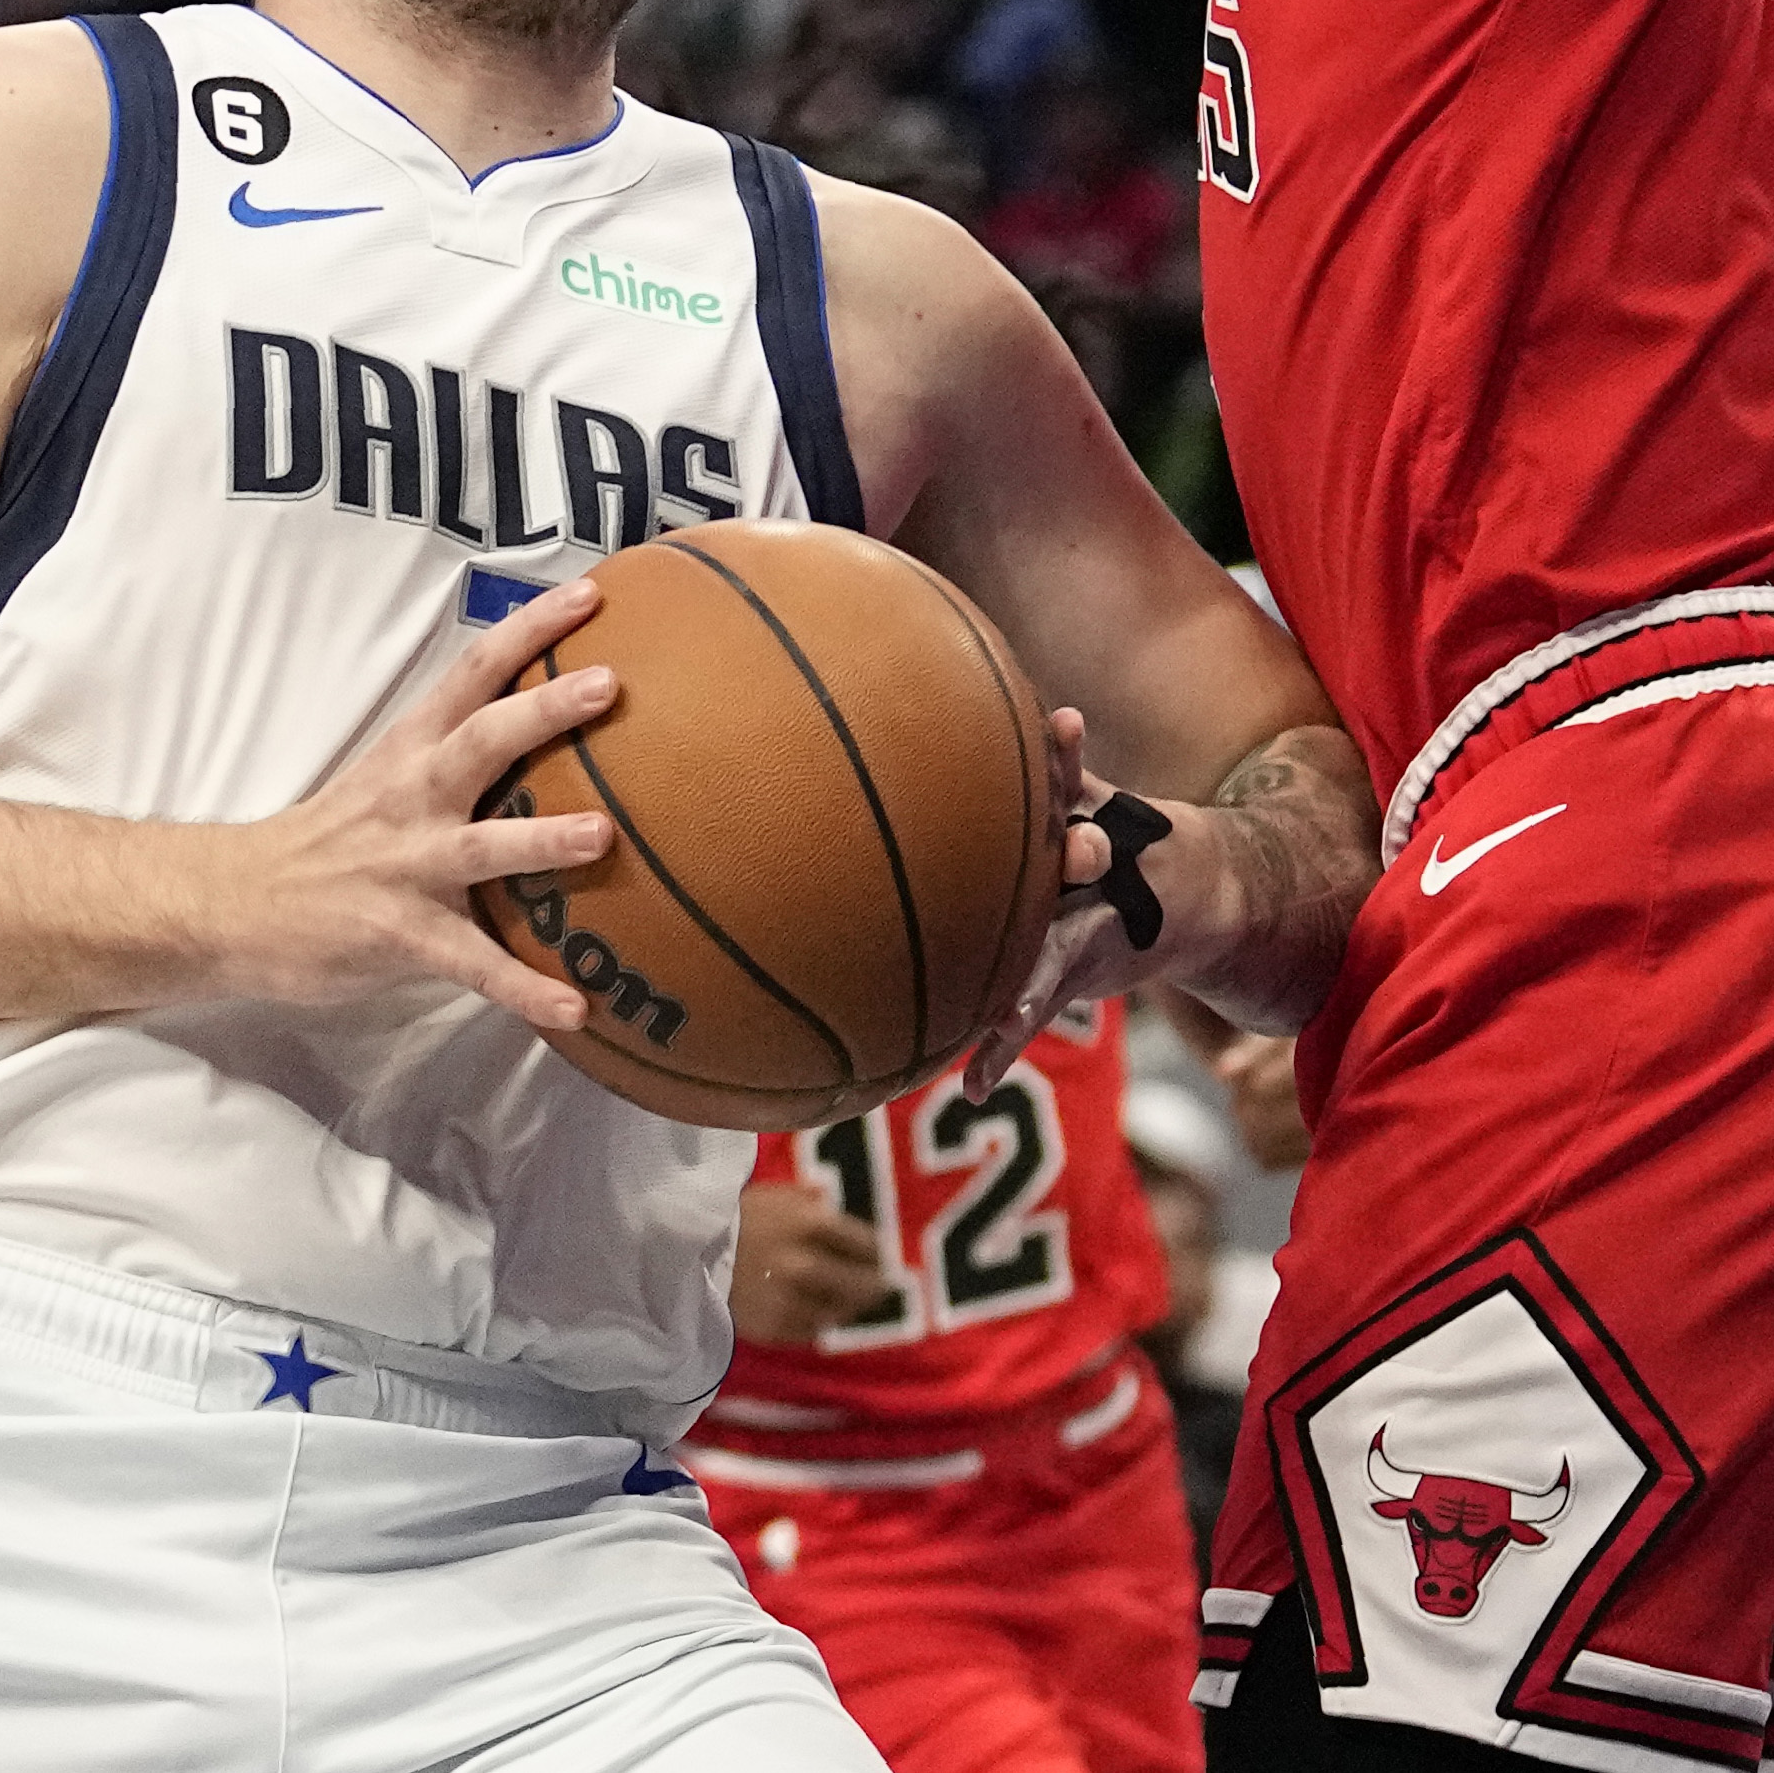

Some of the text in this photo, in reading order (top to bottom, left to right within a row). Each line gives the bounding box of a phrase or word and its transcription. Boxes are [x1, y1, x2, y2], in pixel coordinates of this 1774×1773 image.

[211, 88, 263, 155] 6
[560, 252, 724, 324] chime
[225, 321, 743, 554] DALLAS
[794, 1059, 1075, 1355] 12
